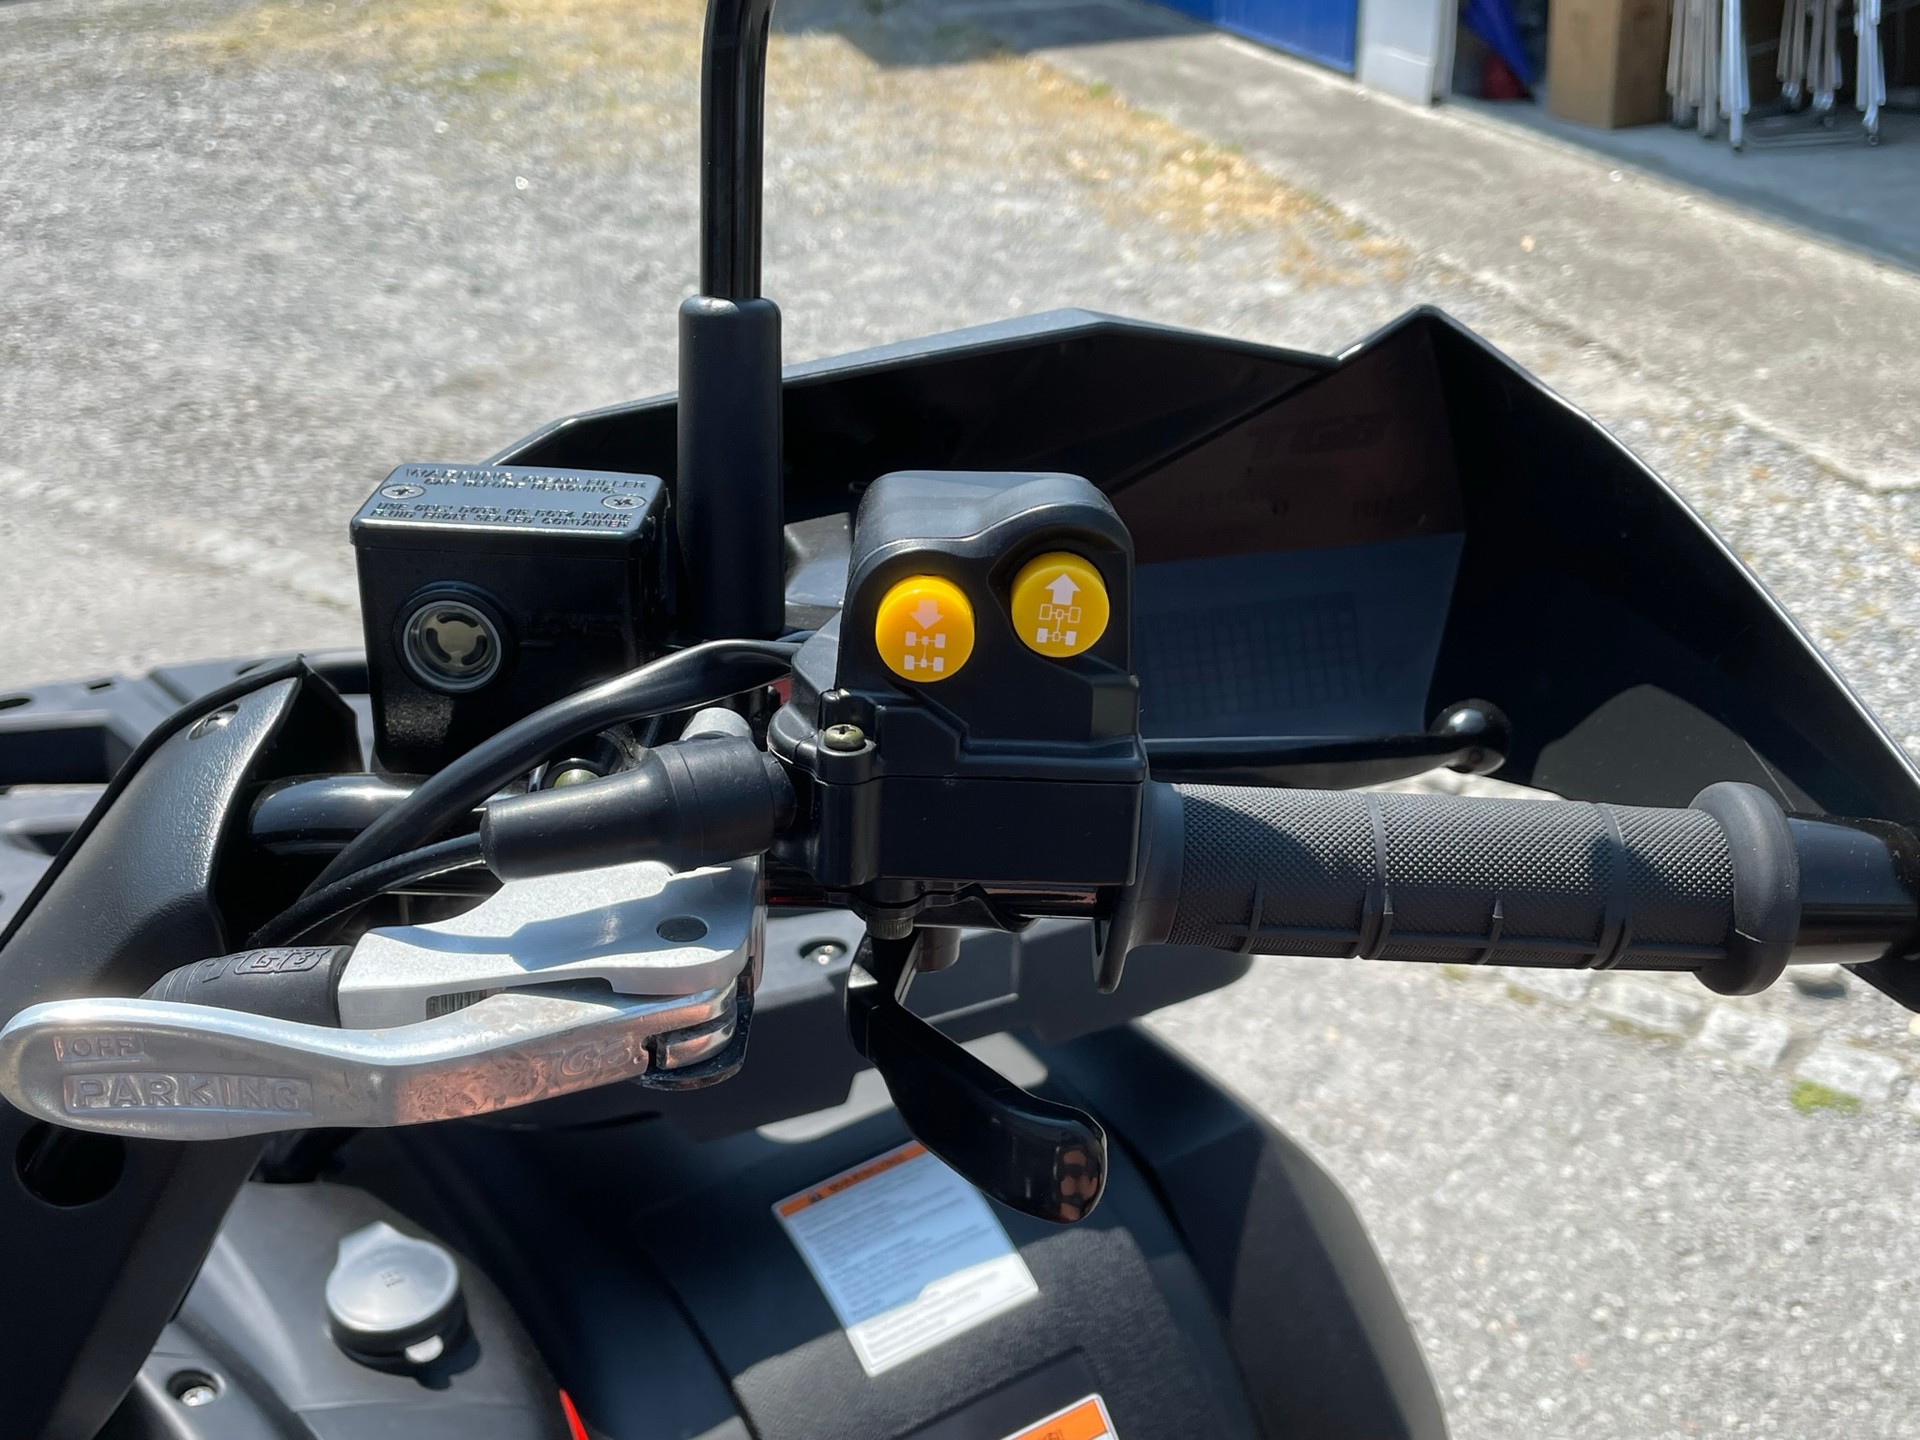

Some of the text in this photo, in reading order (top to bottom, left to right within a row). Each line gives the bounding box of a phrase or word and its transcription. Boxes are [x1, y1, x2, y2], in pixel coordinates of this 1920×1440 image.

[586, 479, 648, 489] FILLER
[376, 502, 409, 510] USE
[582, 511, 634, 522] BRAKE
[71, 1036, 133, 1058] OFF
[73, 1074, 300, 1110] PARKING
